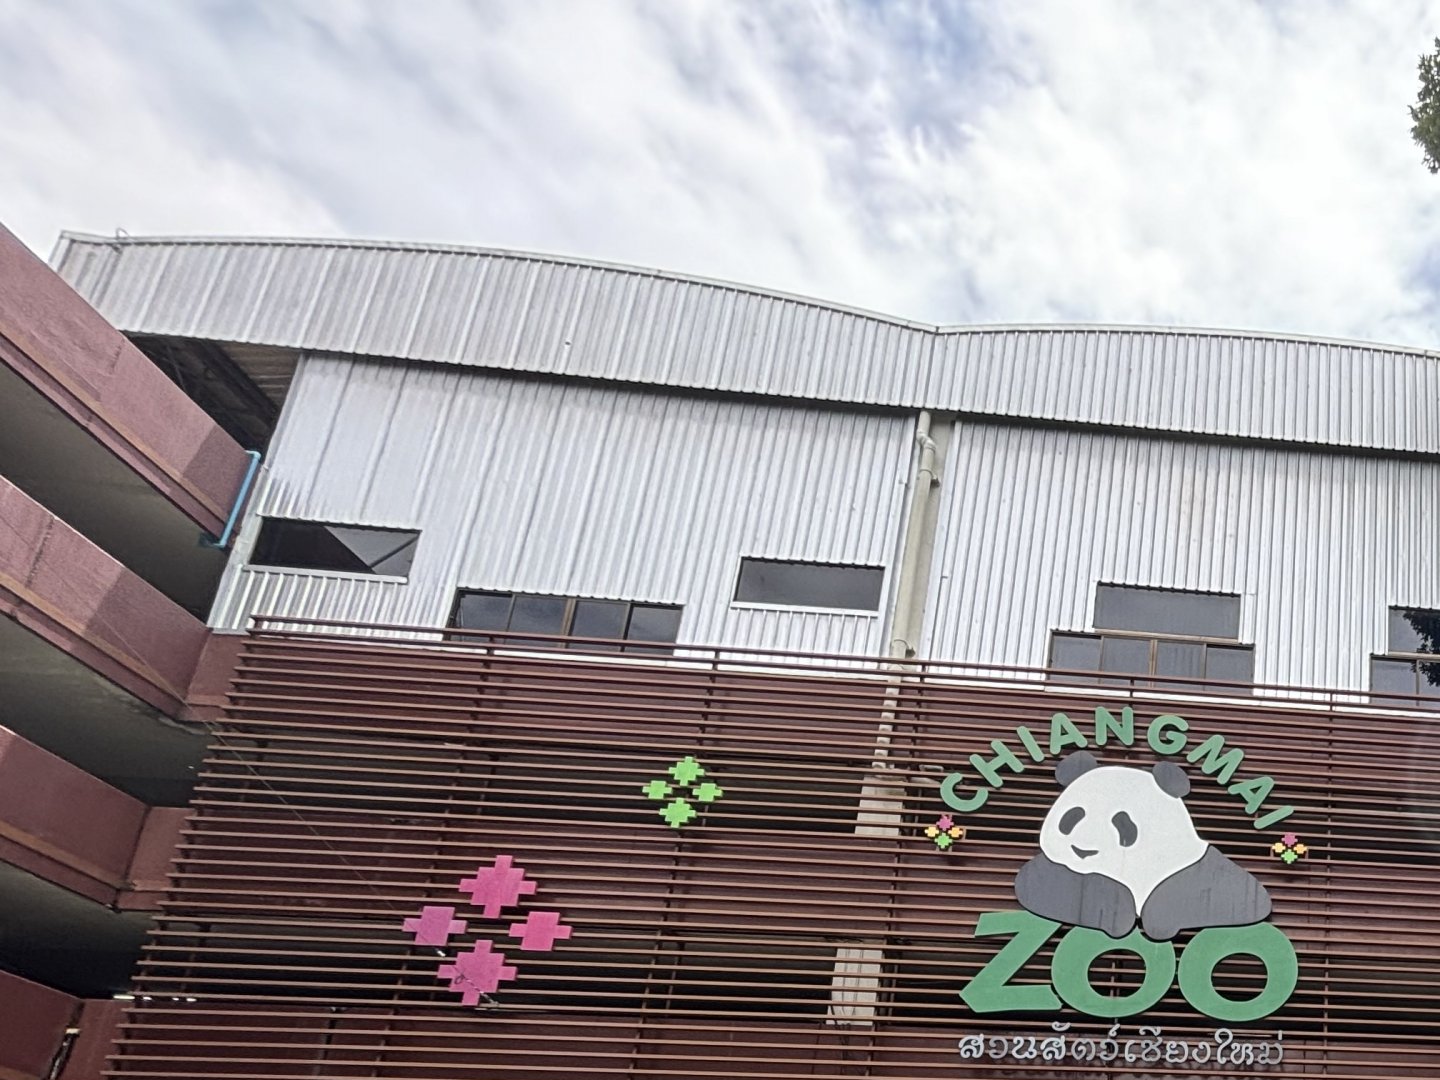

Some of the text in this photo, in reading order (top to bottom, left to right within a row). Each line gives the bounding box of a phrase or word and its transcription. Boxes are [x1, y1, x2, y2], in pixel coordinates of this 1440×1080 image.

[939, 706, 1295, 830] CHIANGMAI
[958, 910, 1299, 1022] ZOO
[958, 1021, 1284, 1066] สวนสัตว์เชียงใหม่
